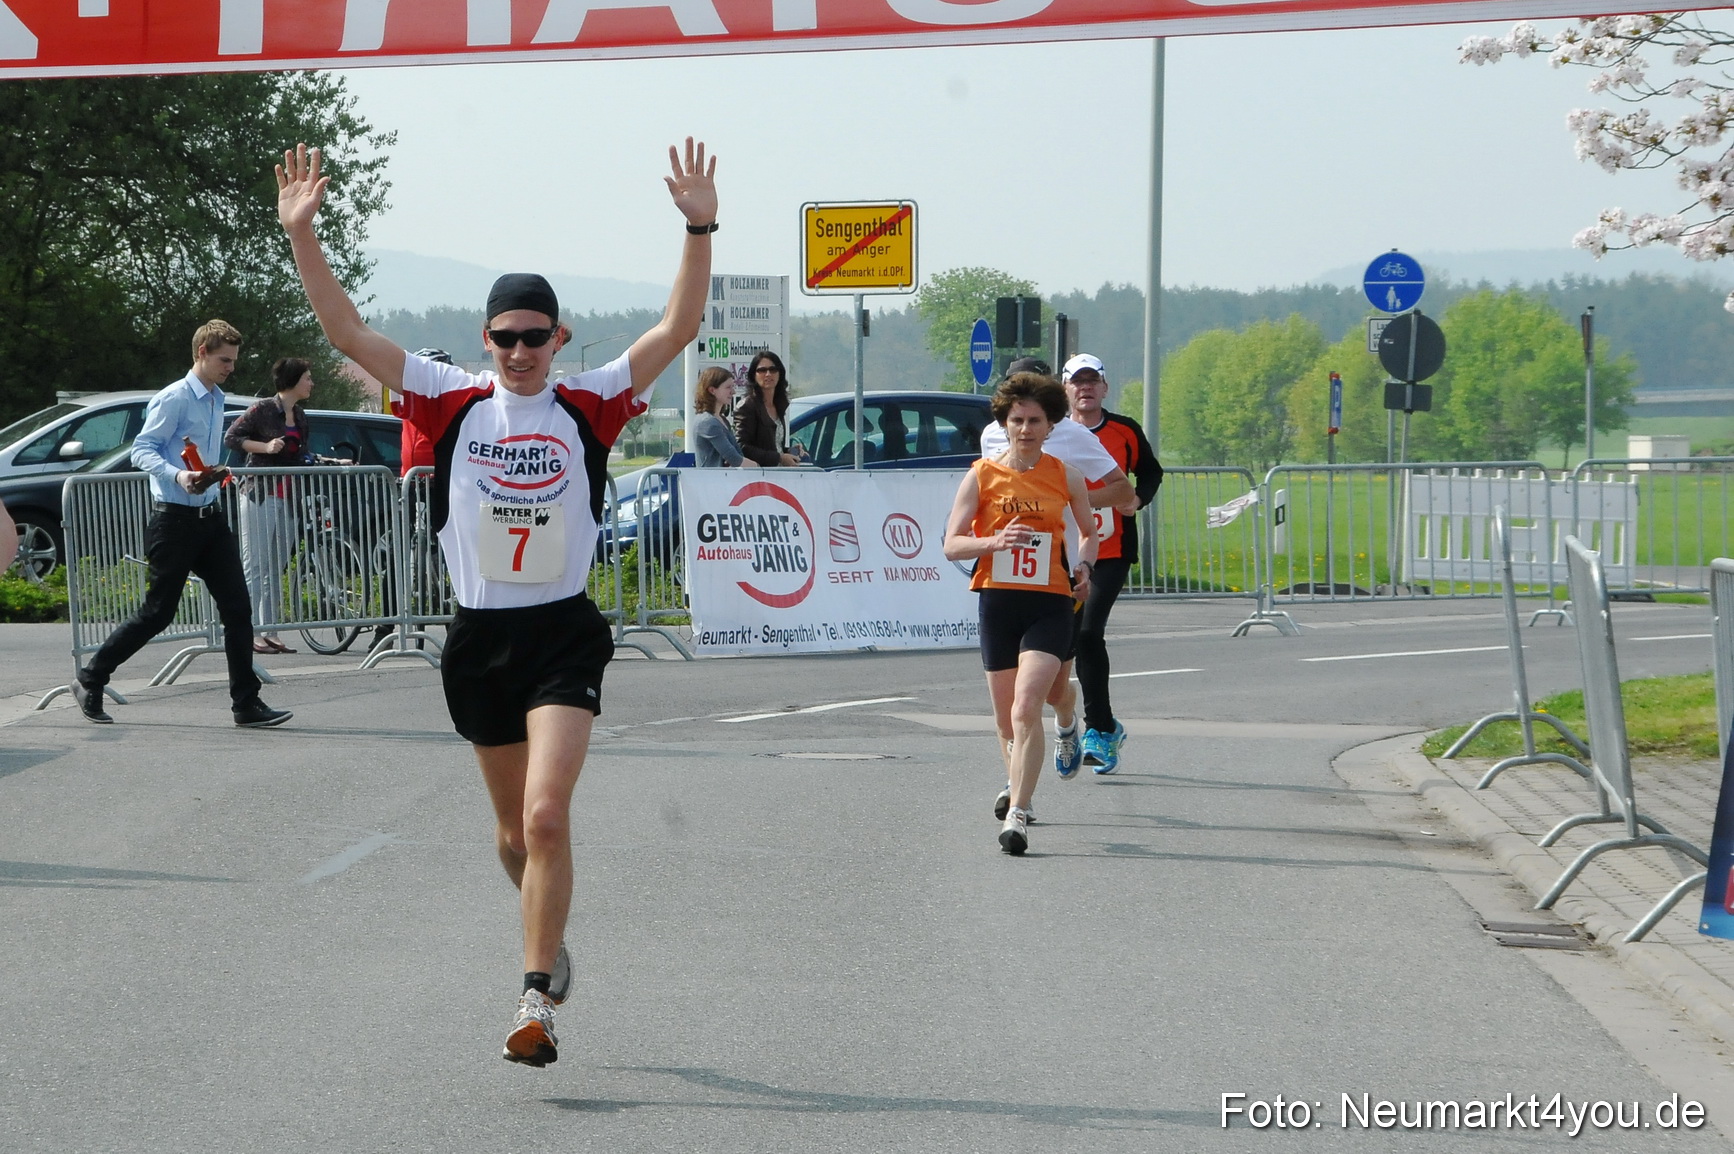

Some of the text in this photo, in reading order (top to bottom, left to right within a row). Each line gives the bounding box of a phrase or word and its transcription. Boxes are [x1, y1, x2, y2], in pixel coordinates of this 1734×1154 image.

[816, 217, 902, 242] Sengenthal
[827, 244, 890, 258] am Anger
[836, 267, 874, 277] Neumarkt
[730, 277, 769, 290] HOLZAMMER
[730, 306, 769, 319] HOLZAMMER
[708, 337, 729, 359] SHB
[468, 441, 558, 461] GERHART &
[467, 455, 506, 469] Autohaus
[476, 479, 491, 494] Das
[491, 491, 534, 504] sportliche
[492, 506, 532, 517] MEYER
[492, 516, 532, 524] WERBUNG
[697, 513, 800, 543] GERHART &
[888, 524, 918, 548] KIA
[508, 527, 531, 572] 7
[697, 545, 752, 560] Autohaus
[751, 544, 808, 573] JÄNIG
[1010, 548, 1037, 578] 15
[827, 571, 874, 584] SEAT
[884, 566, 940, 582] KIA MOTORS
[762, 624, 817, 647] Sengenthal
[822, 623, 843, 640] Tel.
[908, 618, 980, 641] www.gerhart-jae
